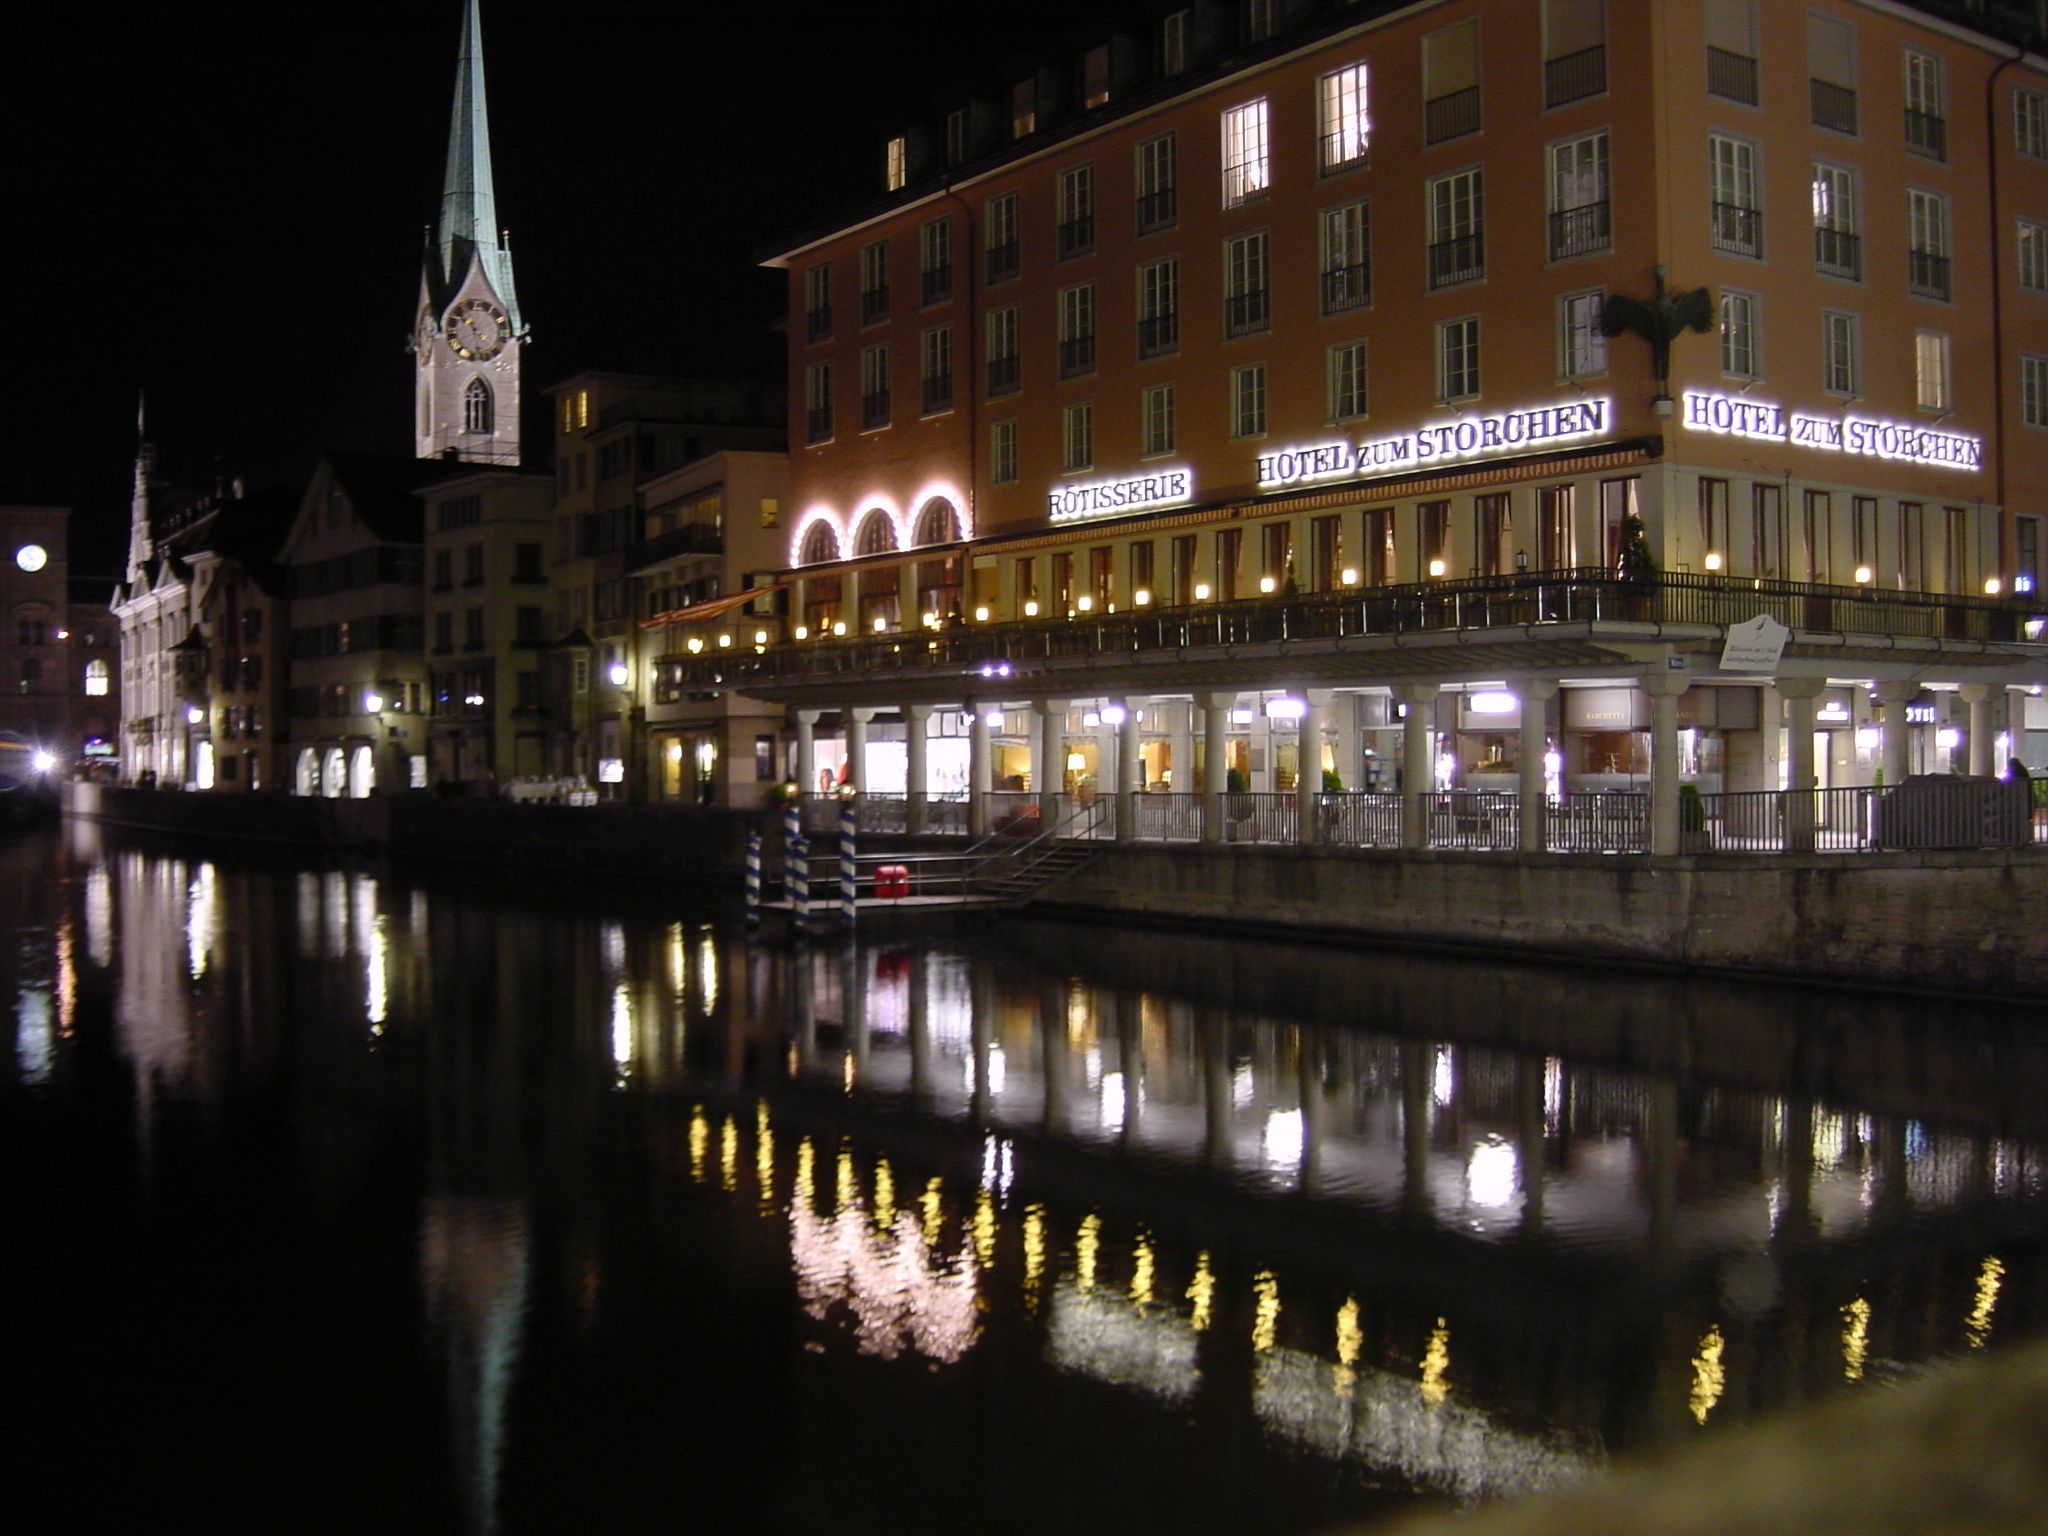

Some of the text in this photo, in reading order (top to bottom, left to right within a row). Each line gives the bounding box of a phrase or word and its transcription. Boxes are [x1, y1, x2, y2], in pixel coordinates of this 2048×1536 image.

[1254, 400, 1606, 483] HOTEL ZUM STORCHEN
[1686, 394, 1983, 466] HOTEL ZUM STORCHEN
